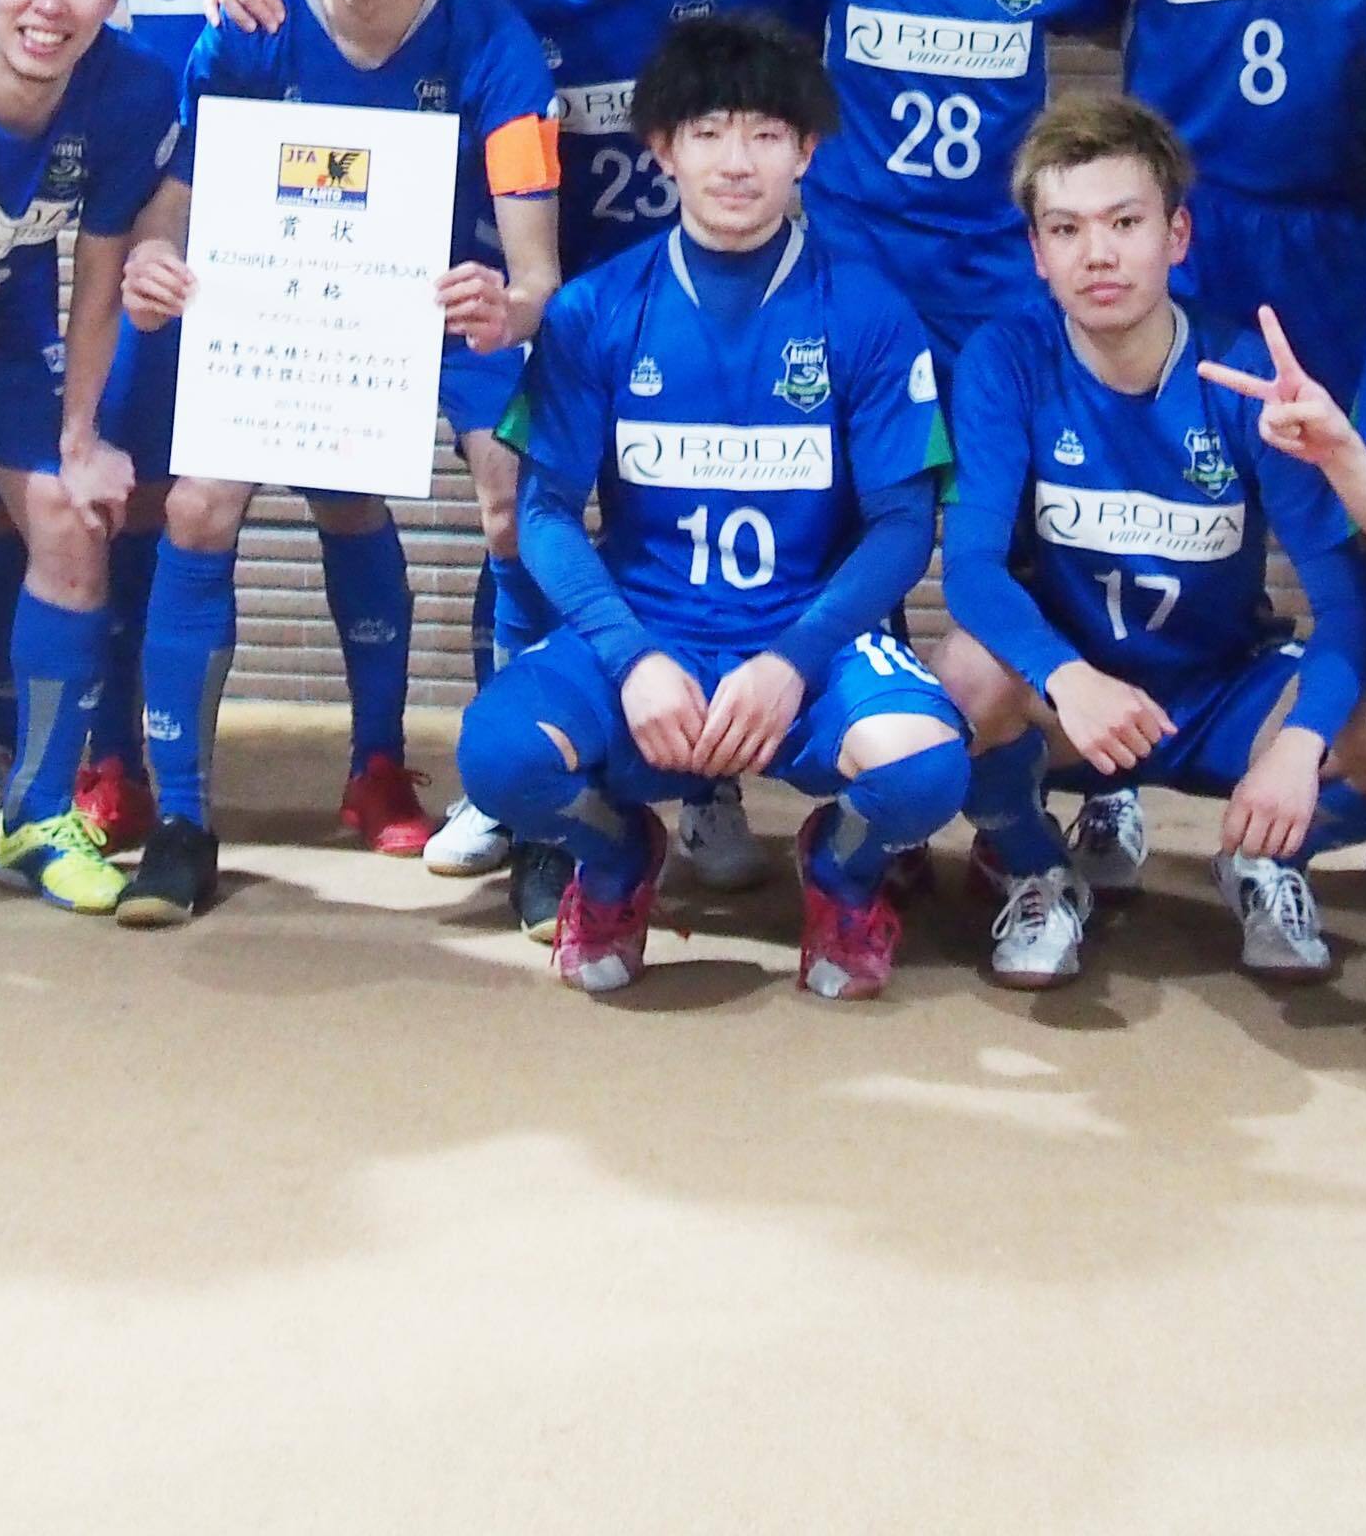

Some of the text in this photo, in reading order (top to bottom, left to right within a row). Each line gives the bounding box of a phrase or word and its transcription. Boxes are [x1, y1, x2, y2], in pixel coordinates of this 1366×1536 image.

[898, 24, 1027, 54] RODA
[1239, 18, 1287, 106] 8
[285, 149, 317, 163] JFA
[886, 89, 981, 180] 28
[591, 147, 680, 222] 23
[680, 437, 825, 464] RODA
[677, 504, 775, 590] 10
[1098, 502, 1239, 536] RODA
[1093, 569, 1181, 641] 17
